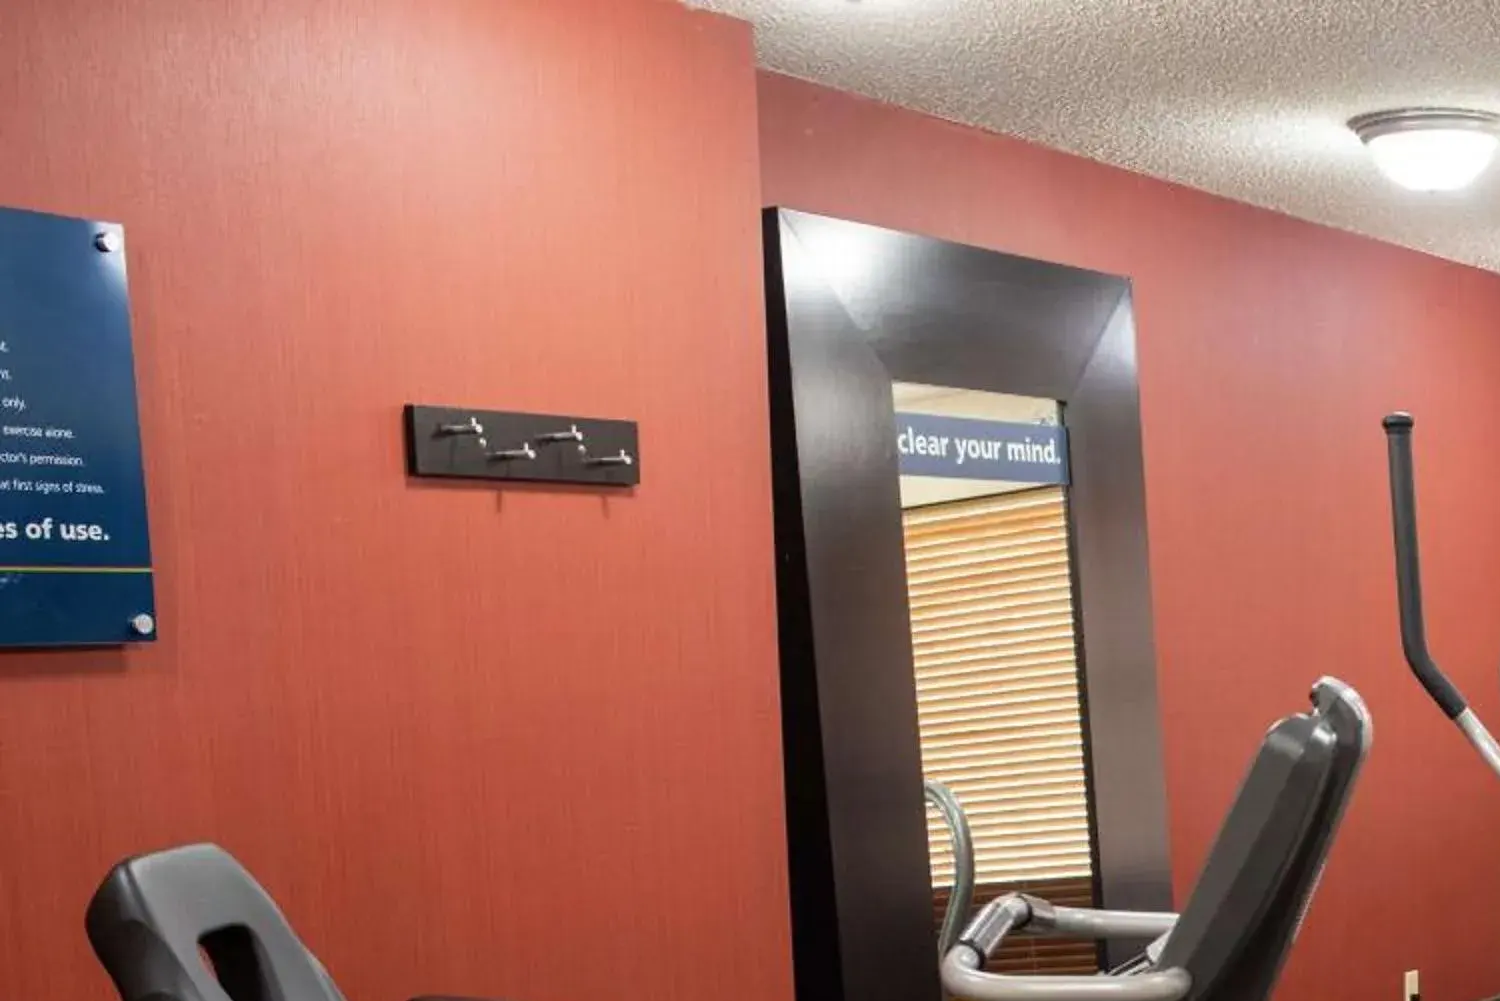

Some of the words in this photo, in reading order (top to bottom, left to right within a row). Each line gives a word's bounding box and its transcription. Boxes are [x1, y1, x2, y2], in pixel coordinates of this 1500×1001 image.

[897, 426, 949, 457] clear
[954, 437, 1001, 465] your
[1007, 436, 1061, 465] mind.
[62, 481, 73, 493] of
[25, 517, 53, 539] of
[60, 523, 110, 541] use.
